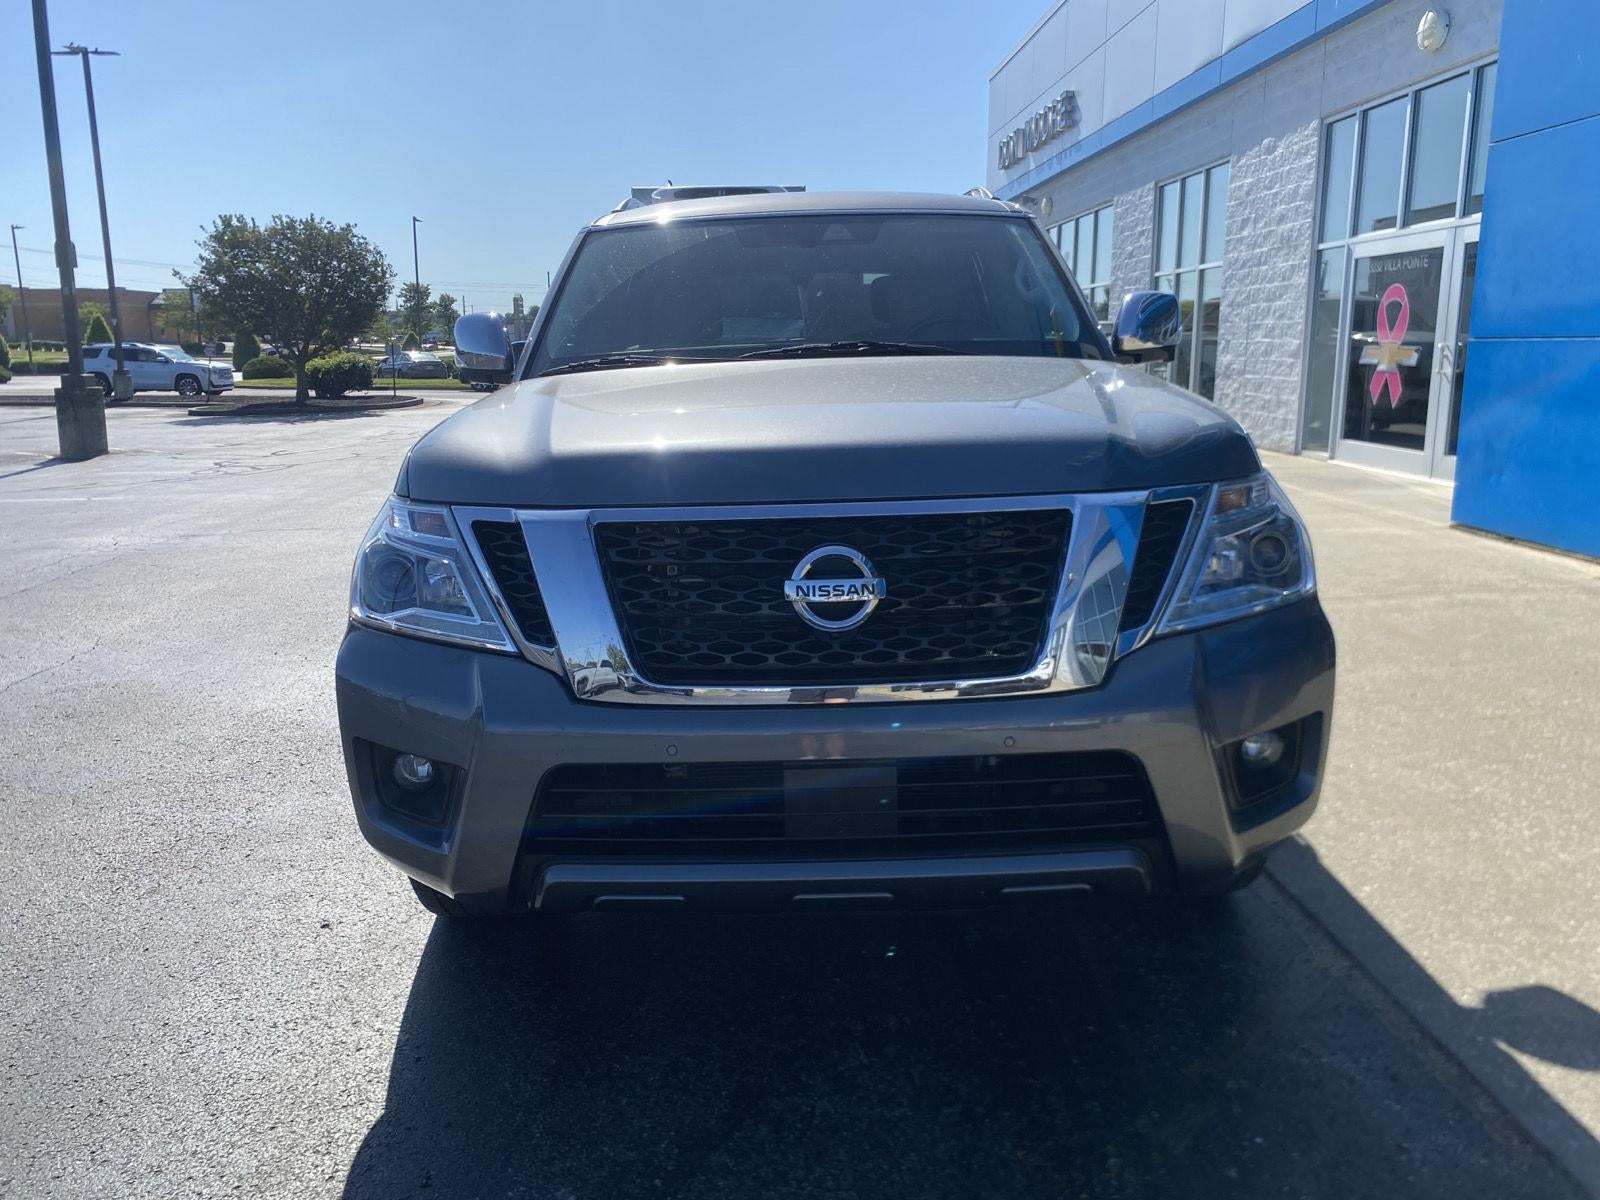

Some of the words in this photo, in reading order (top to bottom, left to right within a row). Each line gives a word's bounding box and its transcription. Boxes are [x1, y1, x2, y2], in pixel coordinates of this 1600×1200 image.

[1384, 258, 1402, 272] VILLA
[1402, 254, 1429, 270] POINTE
[795, 583, 875, 598] NISSAN
